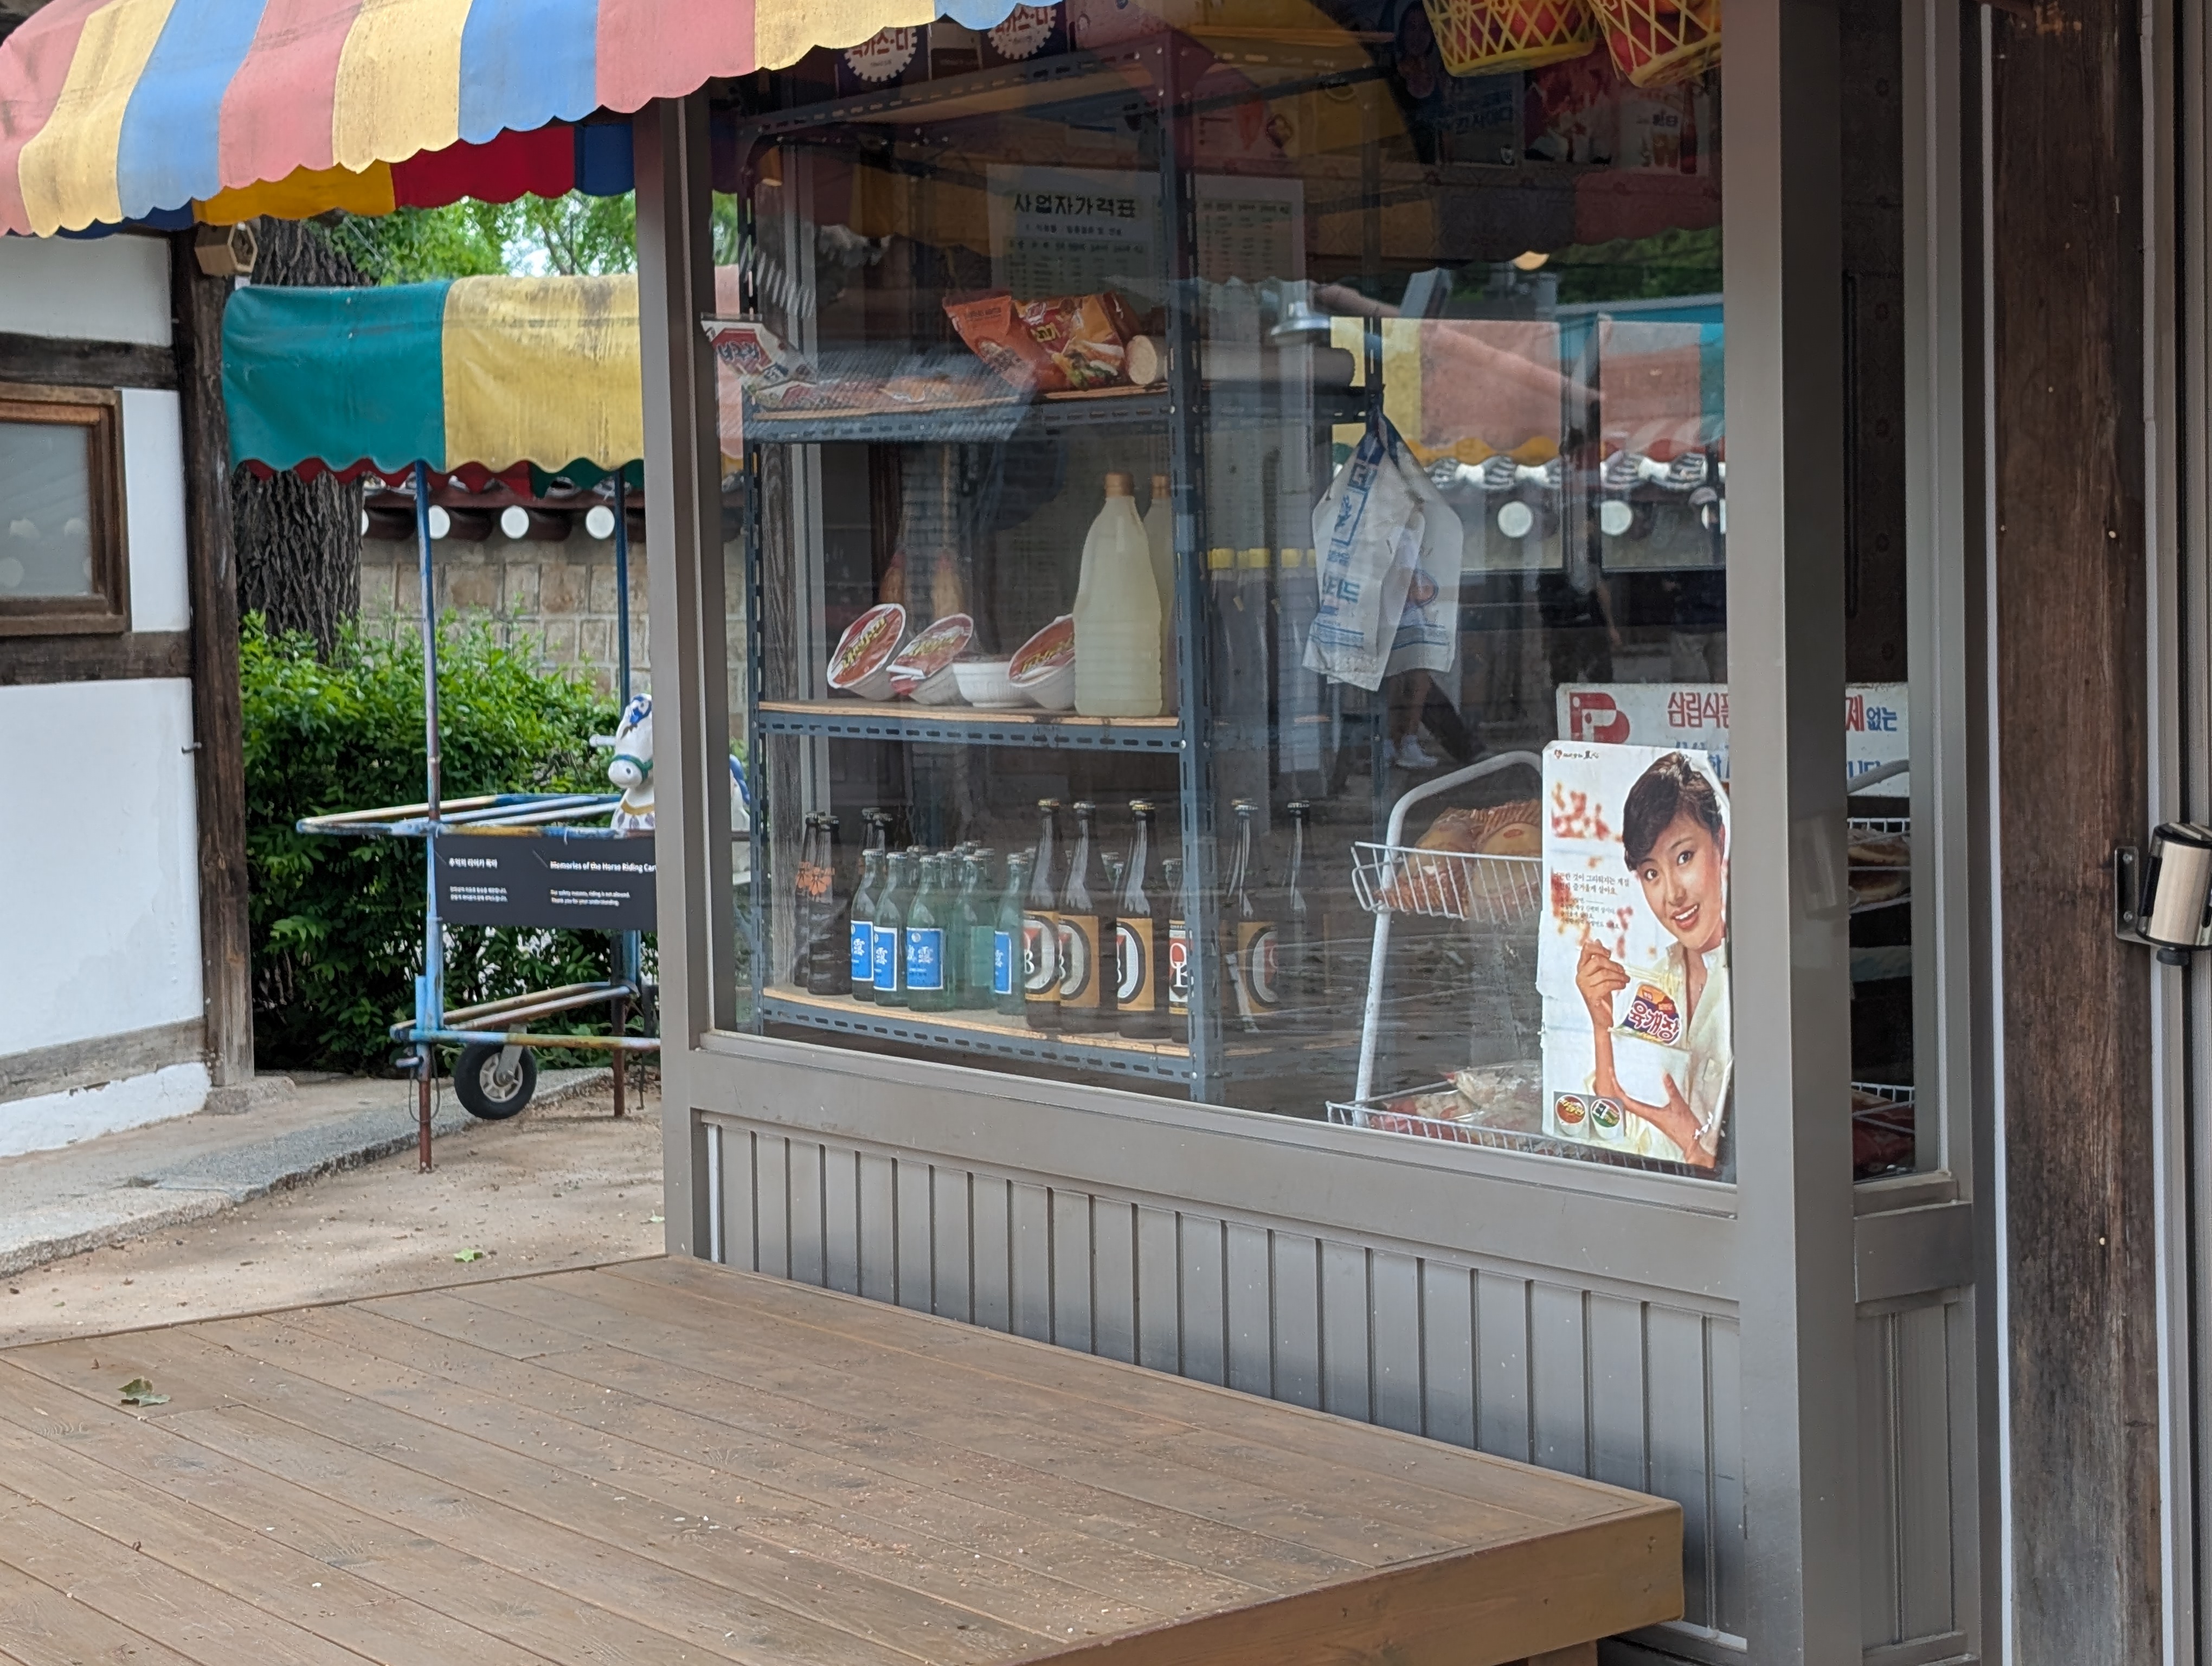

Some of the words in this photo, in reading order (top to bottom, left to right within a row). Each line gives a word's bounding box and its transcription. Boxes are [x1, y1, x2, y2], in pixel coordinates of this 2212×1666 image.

[1866, 706, 1897, 732] 없는
[550, 861, 582, 870] Memories
[582, 862, 589, 870] of
[590, 862, 601, 870] the
[602, 862, 621, 872] Horse
[622, 862, 643, 874] Riding
[1573, 873, 1584, 882] 것이
[1629, 1001, 1680, 1041] 육개장
